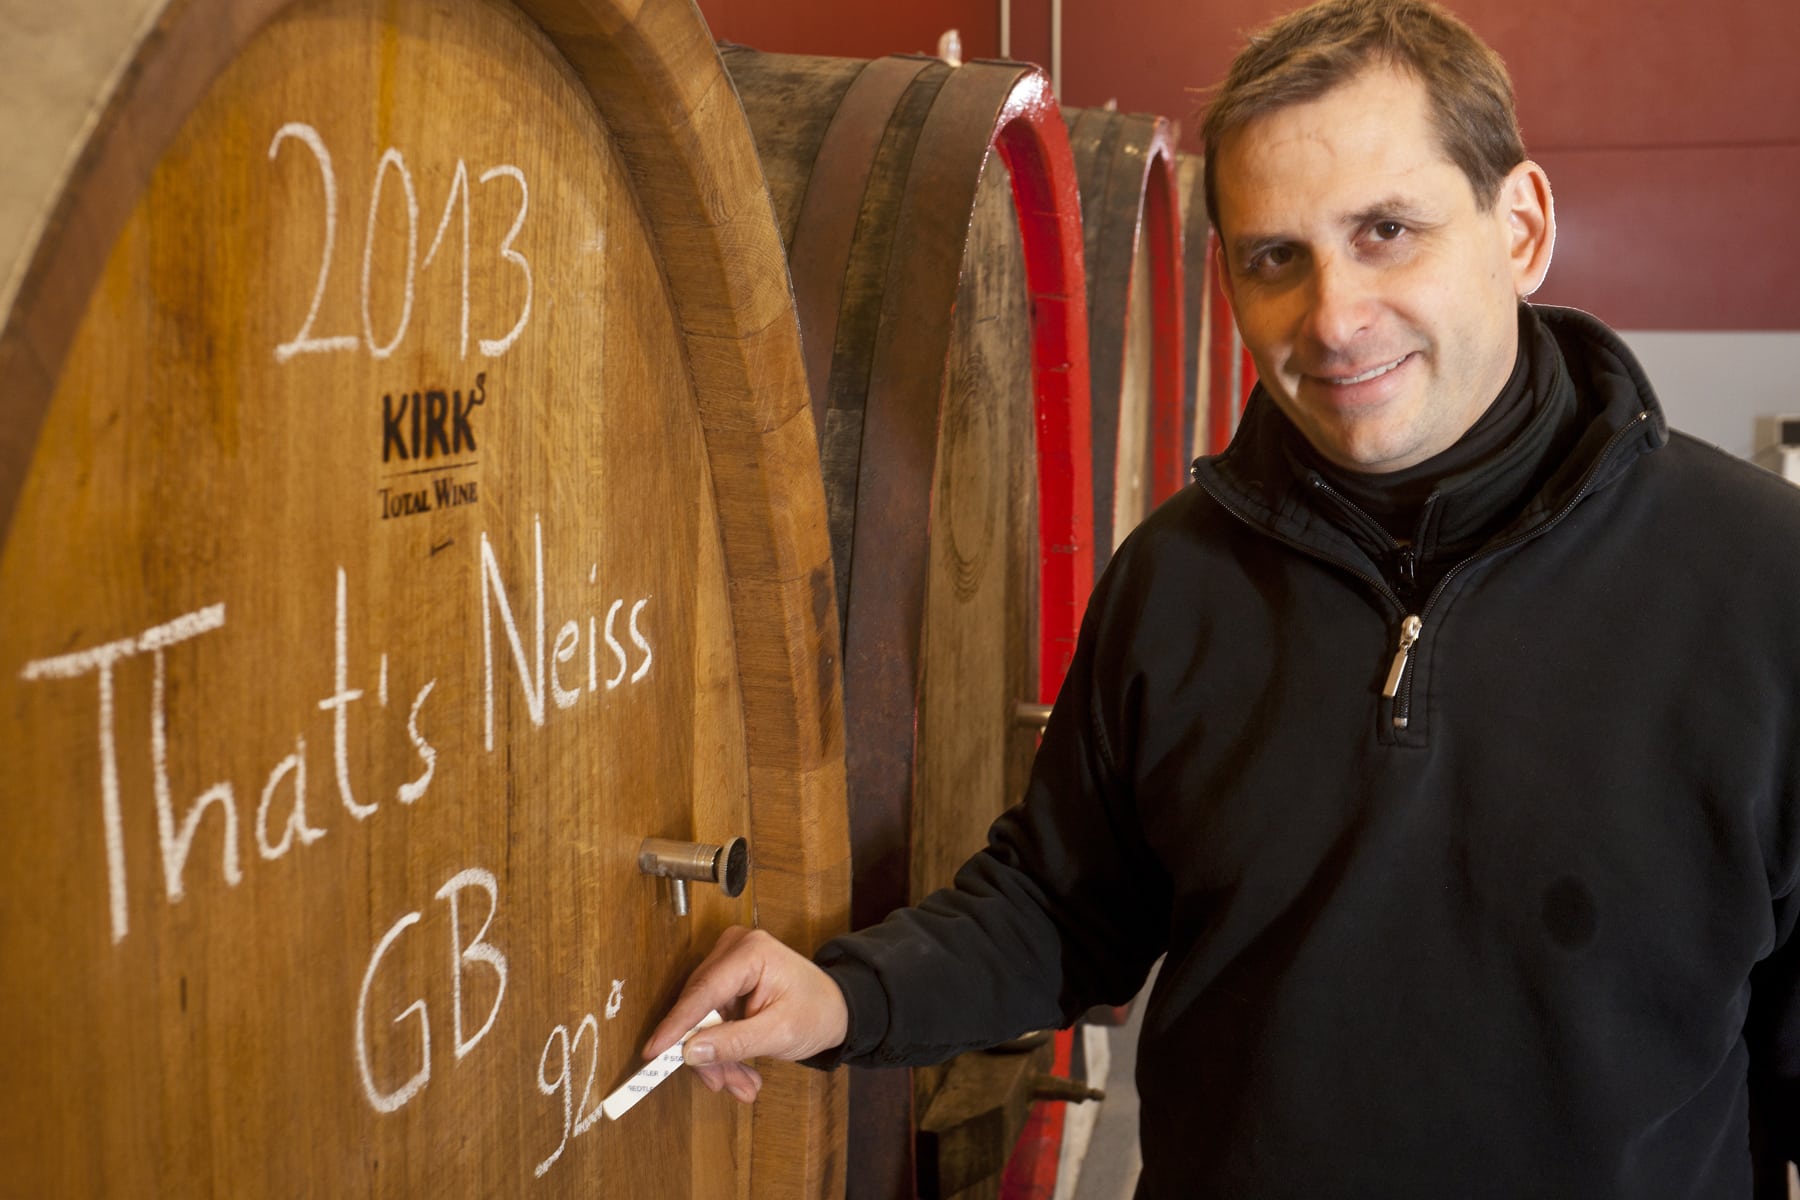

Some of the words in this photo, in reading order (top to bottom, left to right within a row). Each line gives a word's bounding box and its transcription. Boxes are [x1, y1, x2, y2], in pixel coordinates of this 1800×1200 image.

[268, 121, 533, 361] 2013
[379, 487, 432, 520] TOTAL
[433, 477, 478, 510] WINE
[20, 565, 438, 945] That's
[480, 513, 653, 752] Neiss
[354, 867, 507, 1113] GB
